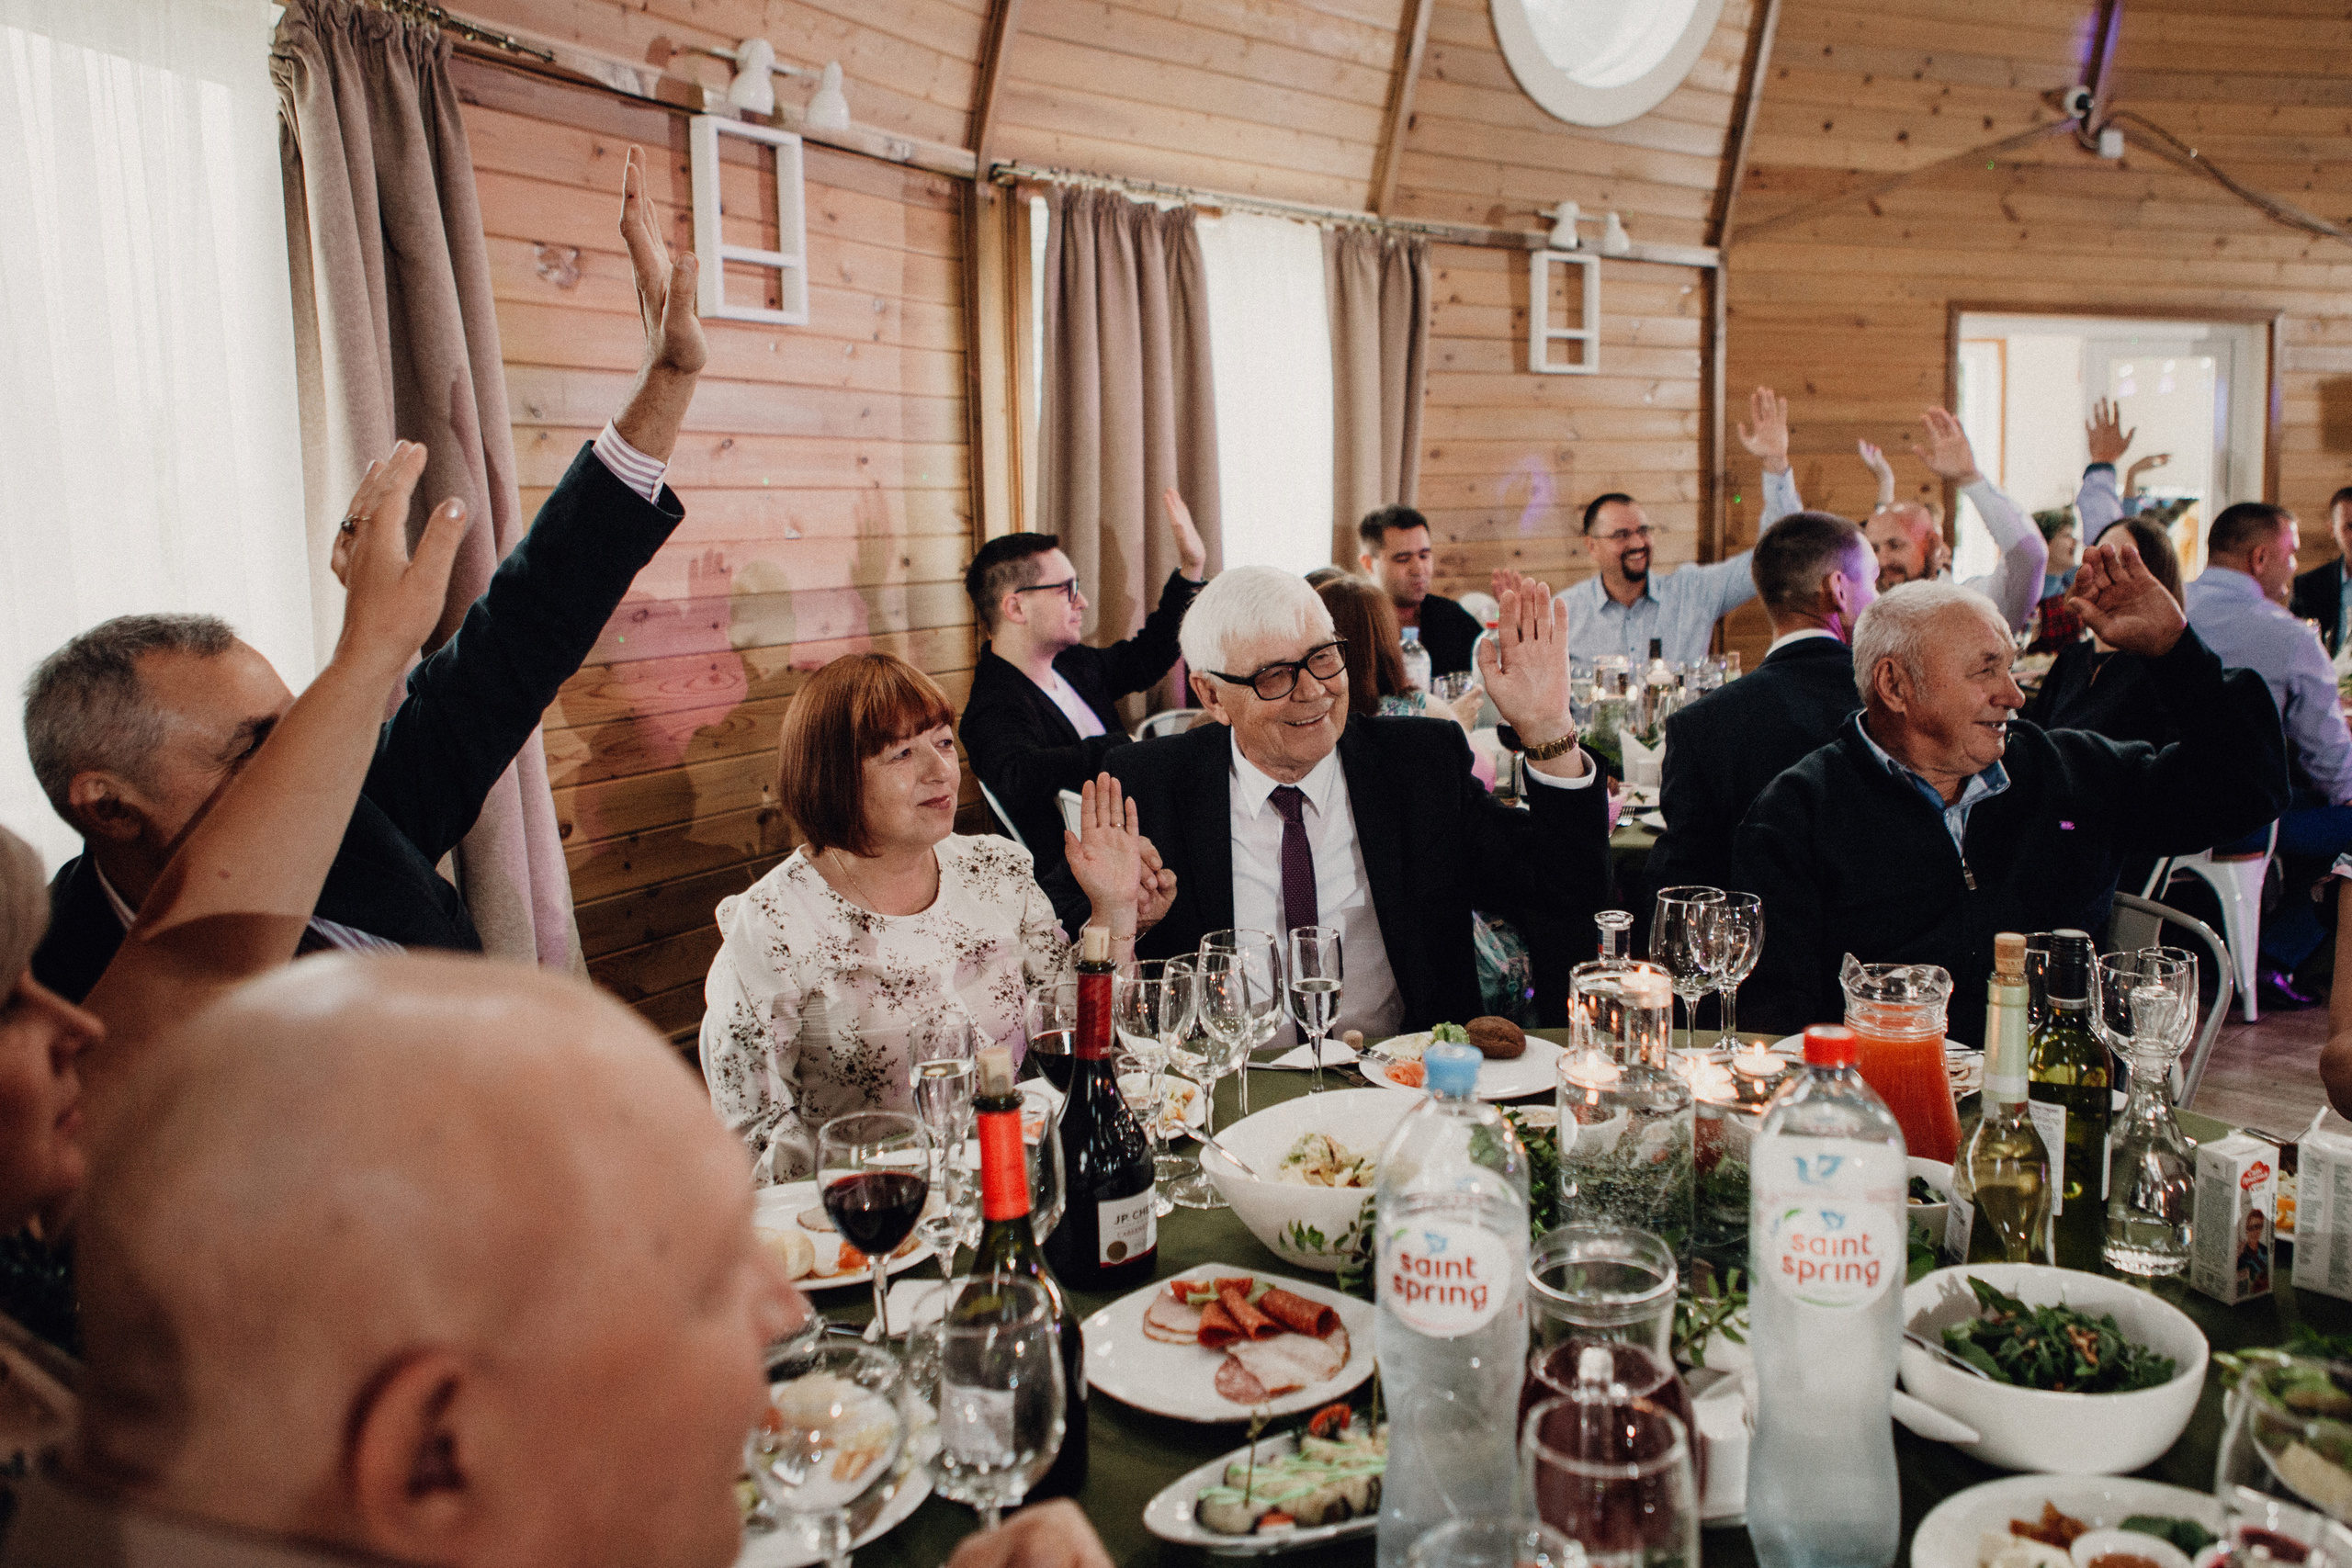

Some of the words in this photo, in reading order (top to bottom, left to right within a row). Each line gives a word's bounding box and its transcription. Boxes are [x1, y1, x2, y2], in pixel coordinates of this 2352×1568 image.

[1792, 1234, 1871, 1257] saint
[1400, 1252, 1477, 1279] saint
[1782, 1255, 1880, 1287] spring
[1393, 1273, 1487, 1312] spring
